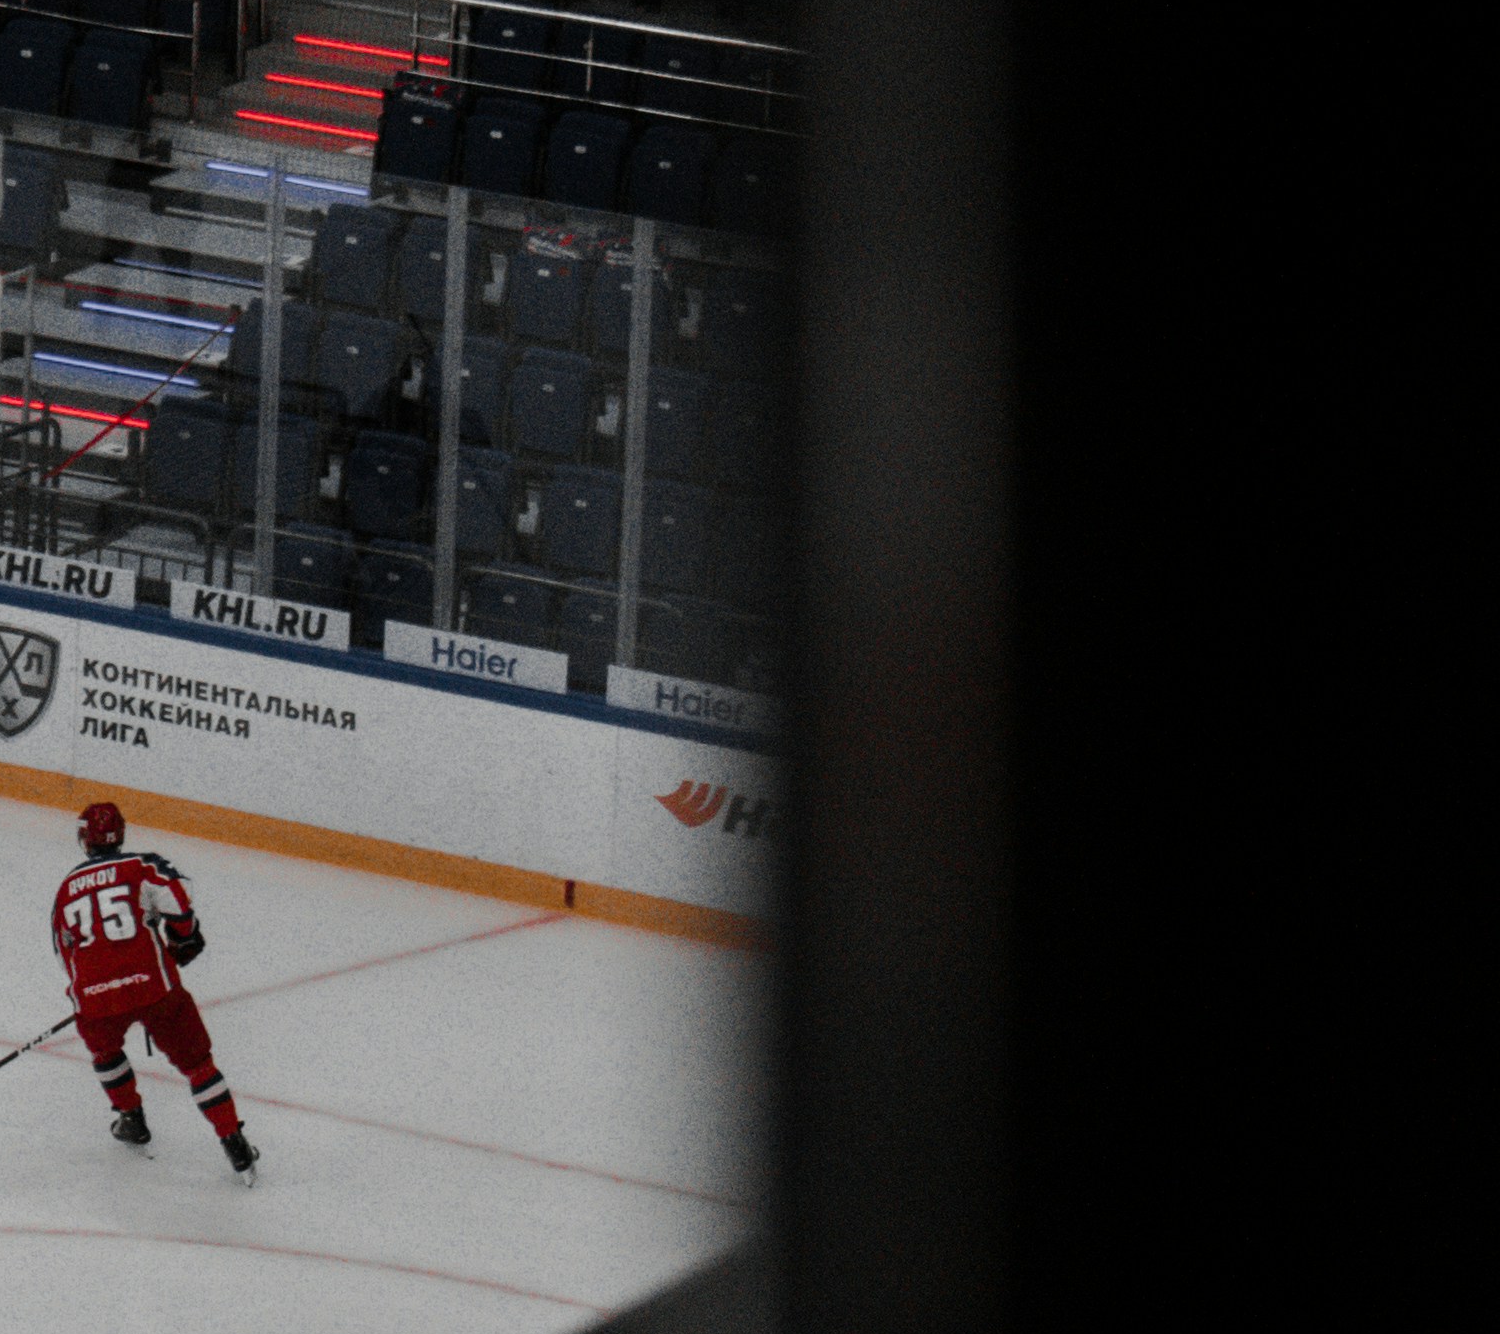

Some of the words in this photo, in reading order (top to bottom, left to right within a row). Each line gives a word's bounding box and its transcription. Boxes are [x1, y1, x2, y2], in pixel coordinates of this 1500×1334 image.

[192, 588, 329, 642] KHL.RU
[430, 635, 519, 680] Haier
[80, 686, 251, 740] ХОККЕЙНАЯ
[82, 657, 357, 732] КОНТИНЕНТАЛЬНАЯ
[653, 680, 743, 725] Haier
[79, 714, 151, 750] ЛИГА
[62, 882, 139, 950] 75
